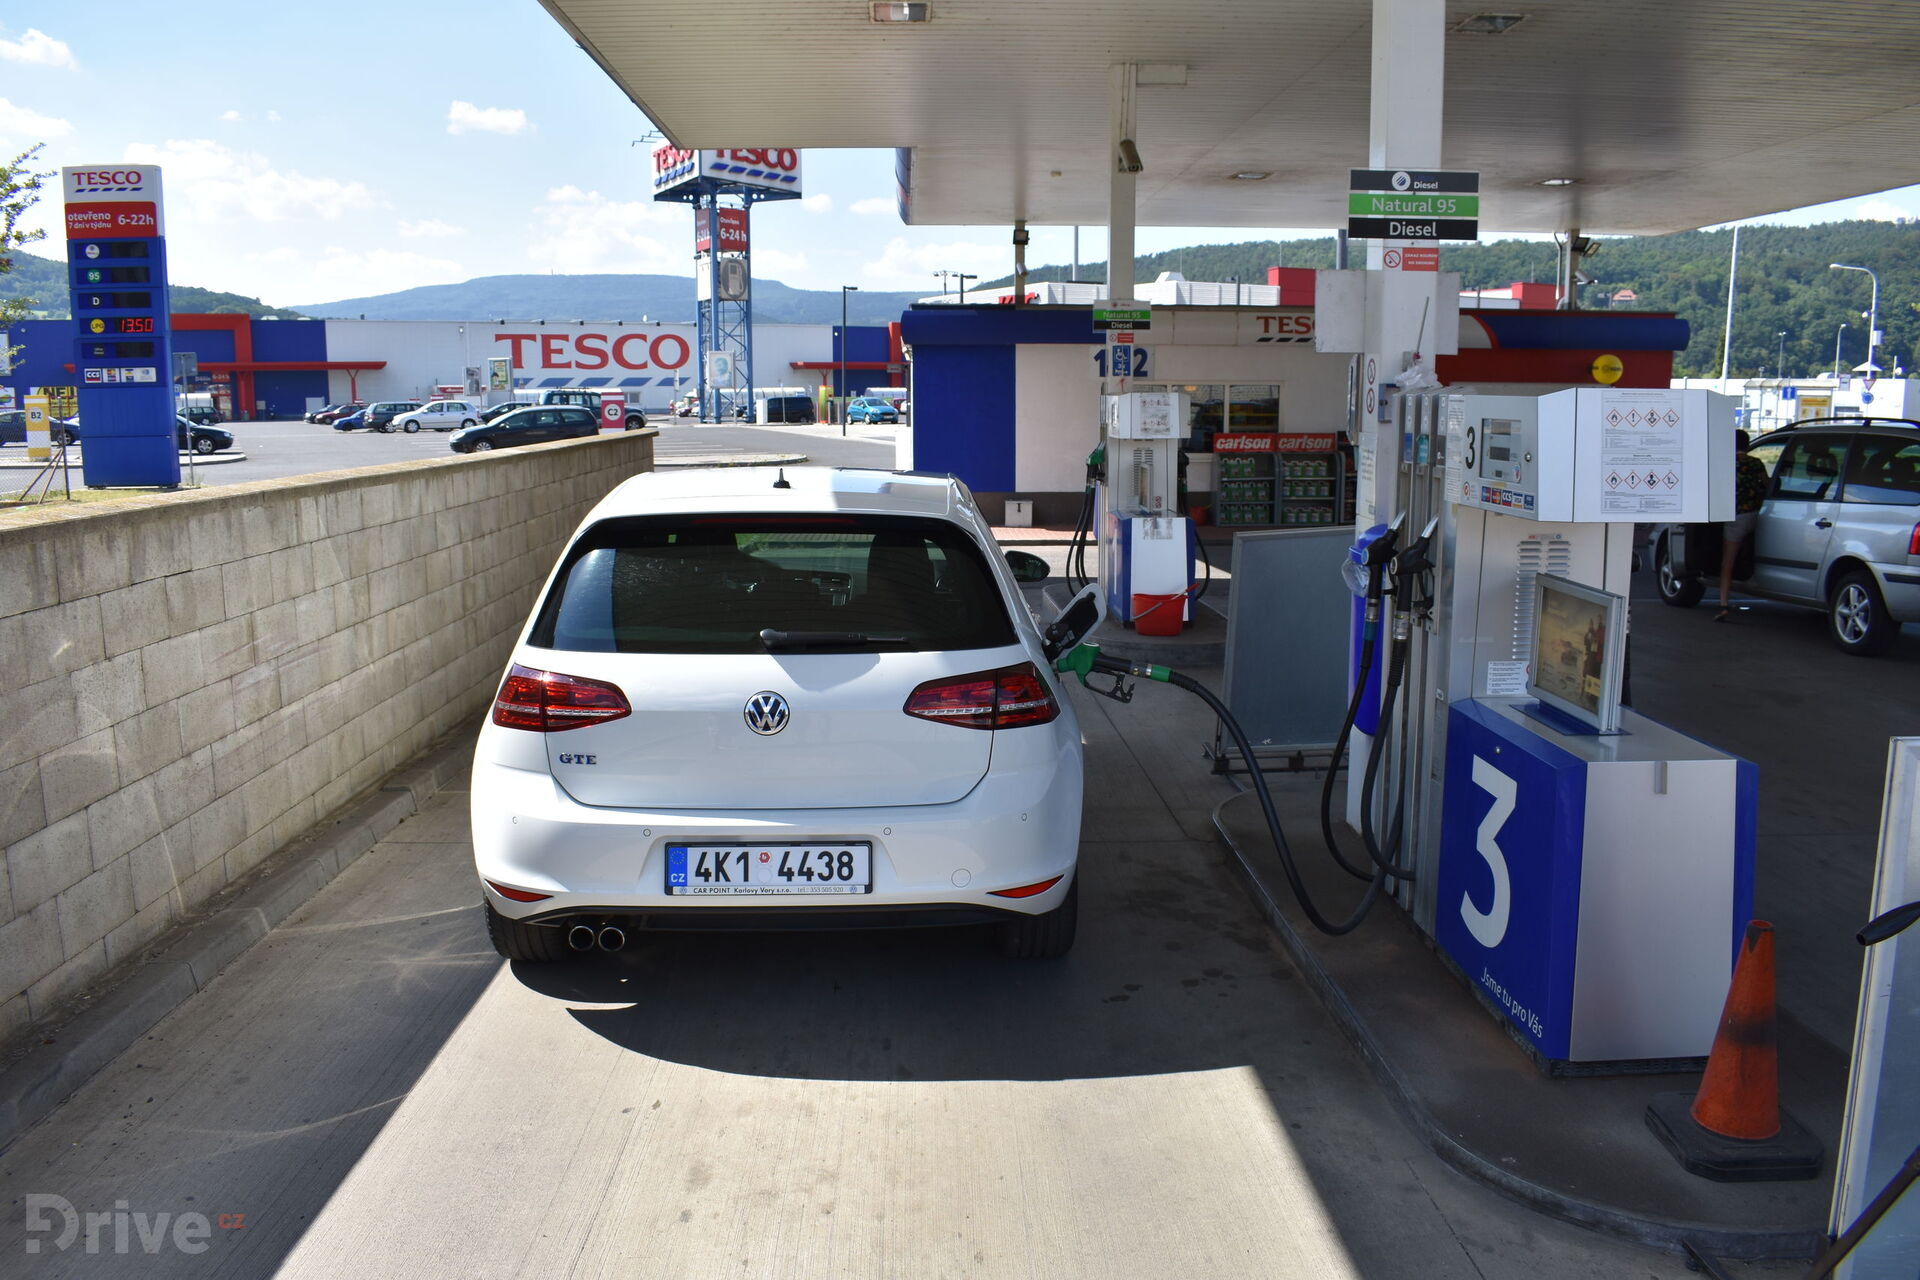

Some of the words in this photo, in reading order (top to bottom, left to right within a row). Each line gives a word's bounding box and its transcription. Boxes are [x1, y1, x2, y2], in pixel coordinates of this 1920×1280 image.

[72, 171, 142, 185] TESCO
[1414, 181, 1438, 189] Diesel
[1372, 198, 1432, 212] Natural
[1437, 199, 1456, 213] 95
[68, 211, 111, 221] otevřeno
[118, 214, 154, 225] 6-22h
[720, 228, 740, 241] 6-24
[1389, 221, 1437, 236] Diesel
[89, 272, 100, 280] 95
[93, 297, 99, 305] D
[1112, 321, 1133, 329] Diesel
[1256, 315, 1315, 334] TES
[495, 333, 690, 370] TESCO
[1134, 347, 1148, 377] 2
[30, 411, 42, 419] B2
[607, 408, 618, 416] C2
[1216, 435, 1271, 449] carlson
[1278, 435, 1332, 449] carlson
[1465, 426, 1476, 469] 3
[559, 753, 597, 765] GTE
[1460, 753, 1517, 948] 3
[670, 873, 685, 883] CZ
[695, 851, 749, 882] 4K1
[777, 850, 854, 882] 4438
[1481, 968, 1501, 998] Jsme
[1503, 989, 1511, 1007] tu
[1512, 1000, 1526, 1022] pro
[1528, 1008, 1543, 1038] Vás
